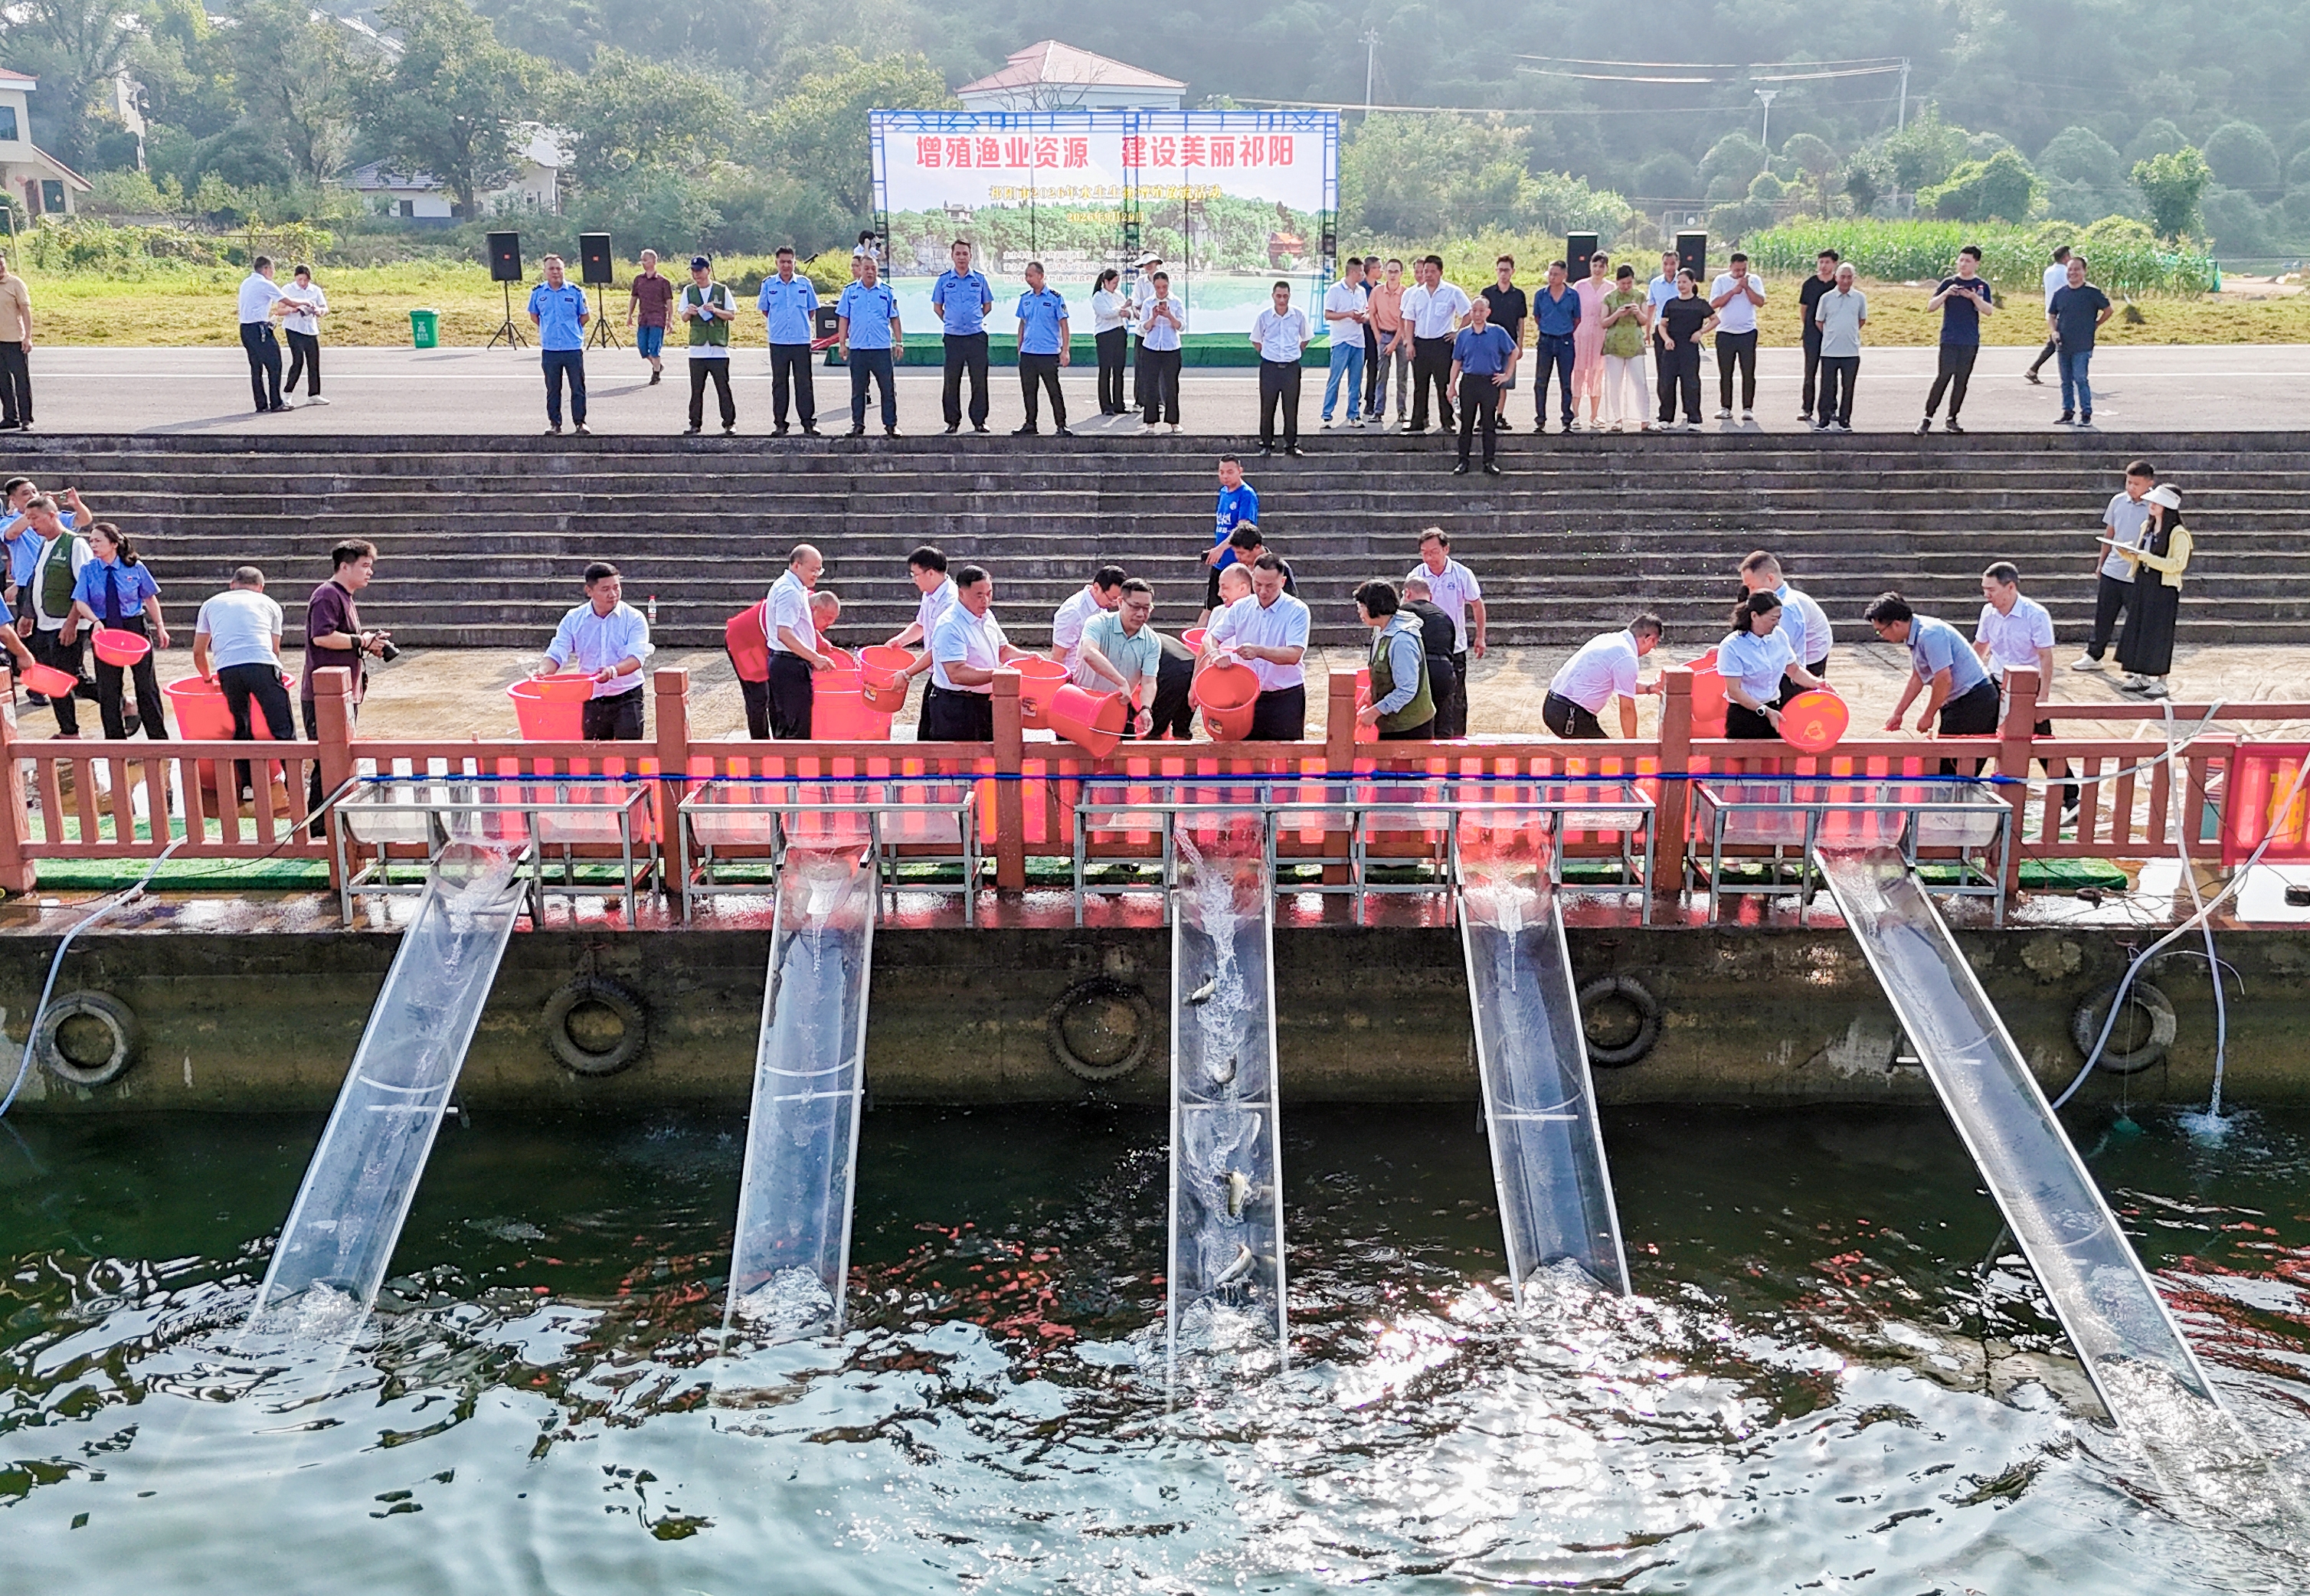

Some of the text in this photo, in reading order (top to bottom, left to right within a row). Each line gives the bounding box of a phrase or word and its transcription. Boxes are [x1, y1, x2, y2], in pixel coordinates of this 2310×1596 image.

[917, 135, 1293, 168] 增殖渔业资源 建设美丽祁阳
